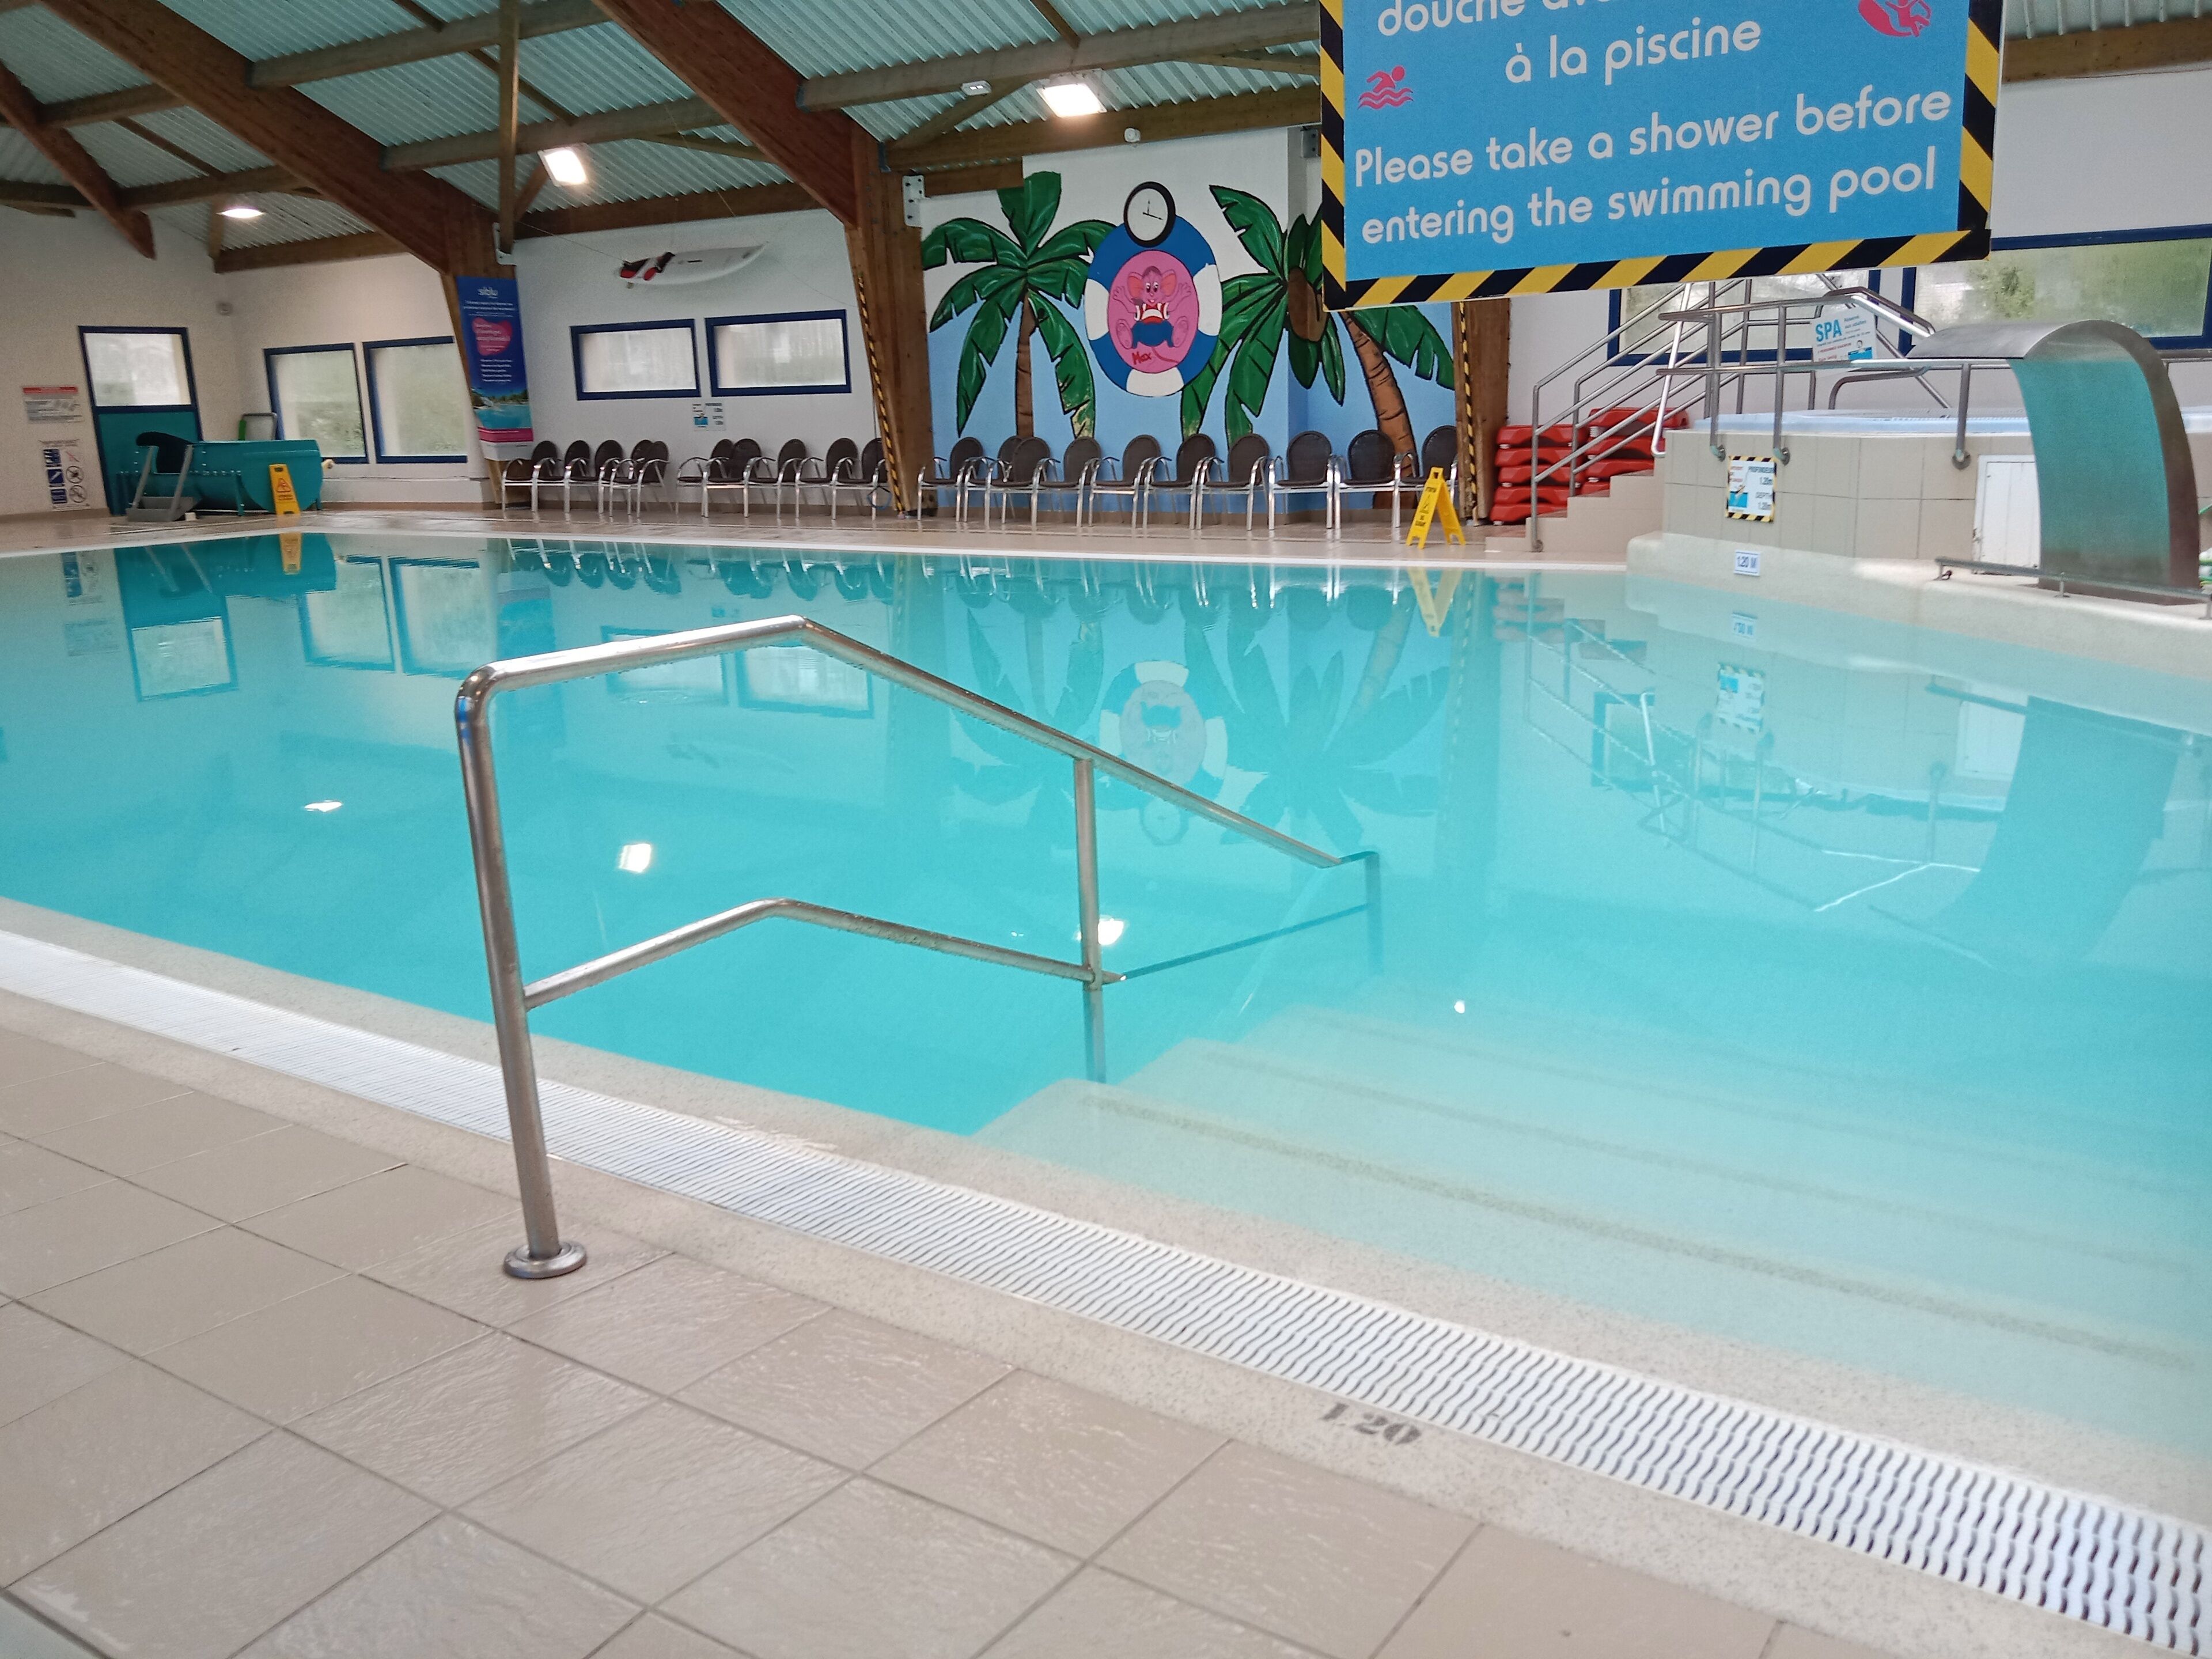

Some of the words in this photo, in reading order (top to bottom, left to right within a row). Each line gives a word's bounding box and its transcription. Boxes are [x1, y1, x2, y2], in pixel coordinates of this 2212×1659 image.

[1505, 43, 1532, 84] à
[1550, 35, 1587, 78] la
[1605, 17, 1761, 85] piscine
[1355, 146, 1473, 187] Please
[1486, 127, 1573, 171] take
[1588, 132, 1613, 159] a
[1630, 111, 1779, 155] shower
[1796, 84, 1951, 135] before
[1362, 200, 1514, 244] entering
[1527, 187, 1593, 226] the
[1608, 169, 1811, 219] swimming
[1829, 146, 1936, 213] pool
[1815, 319, 1842, 342] SPA
